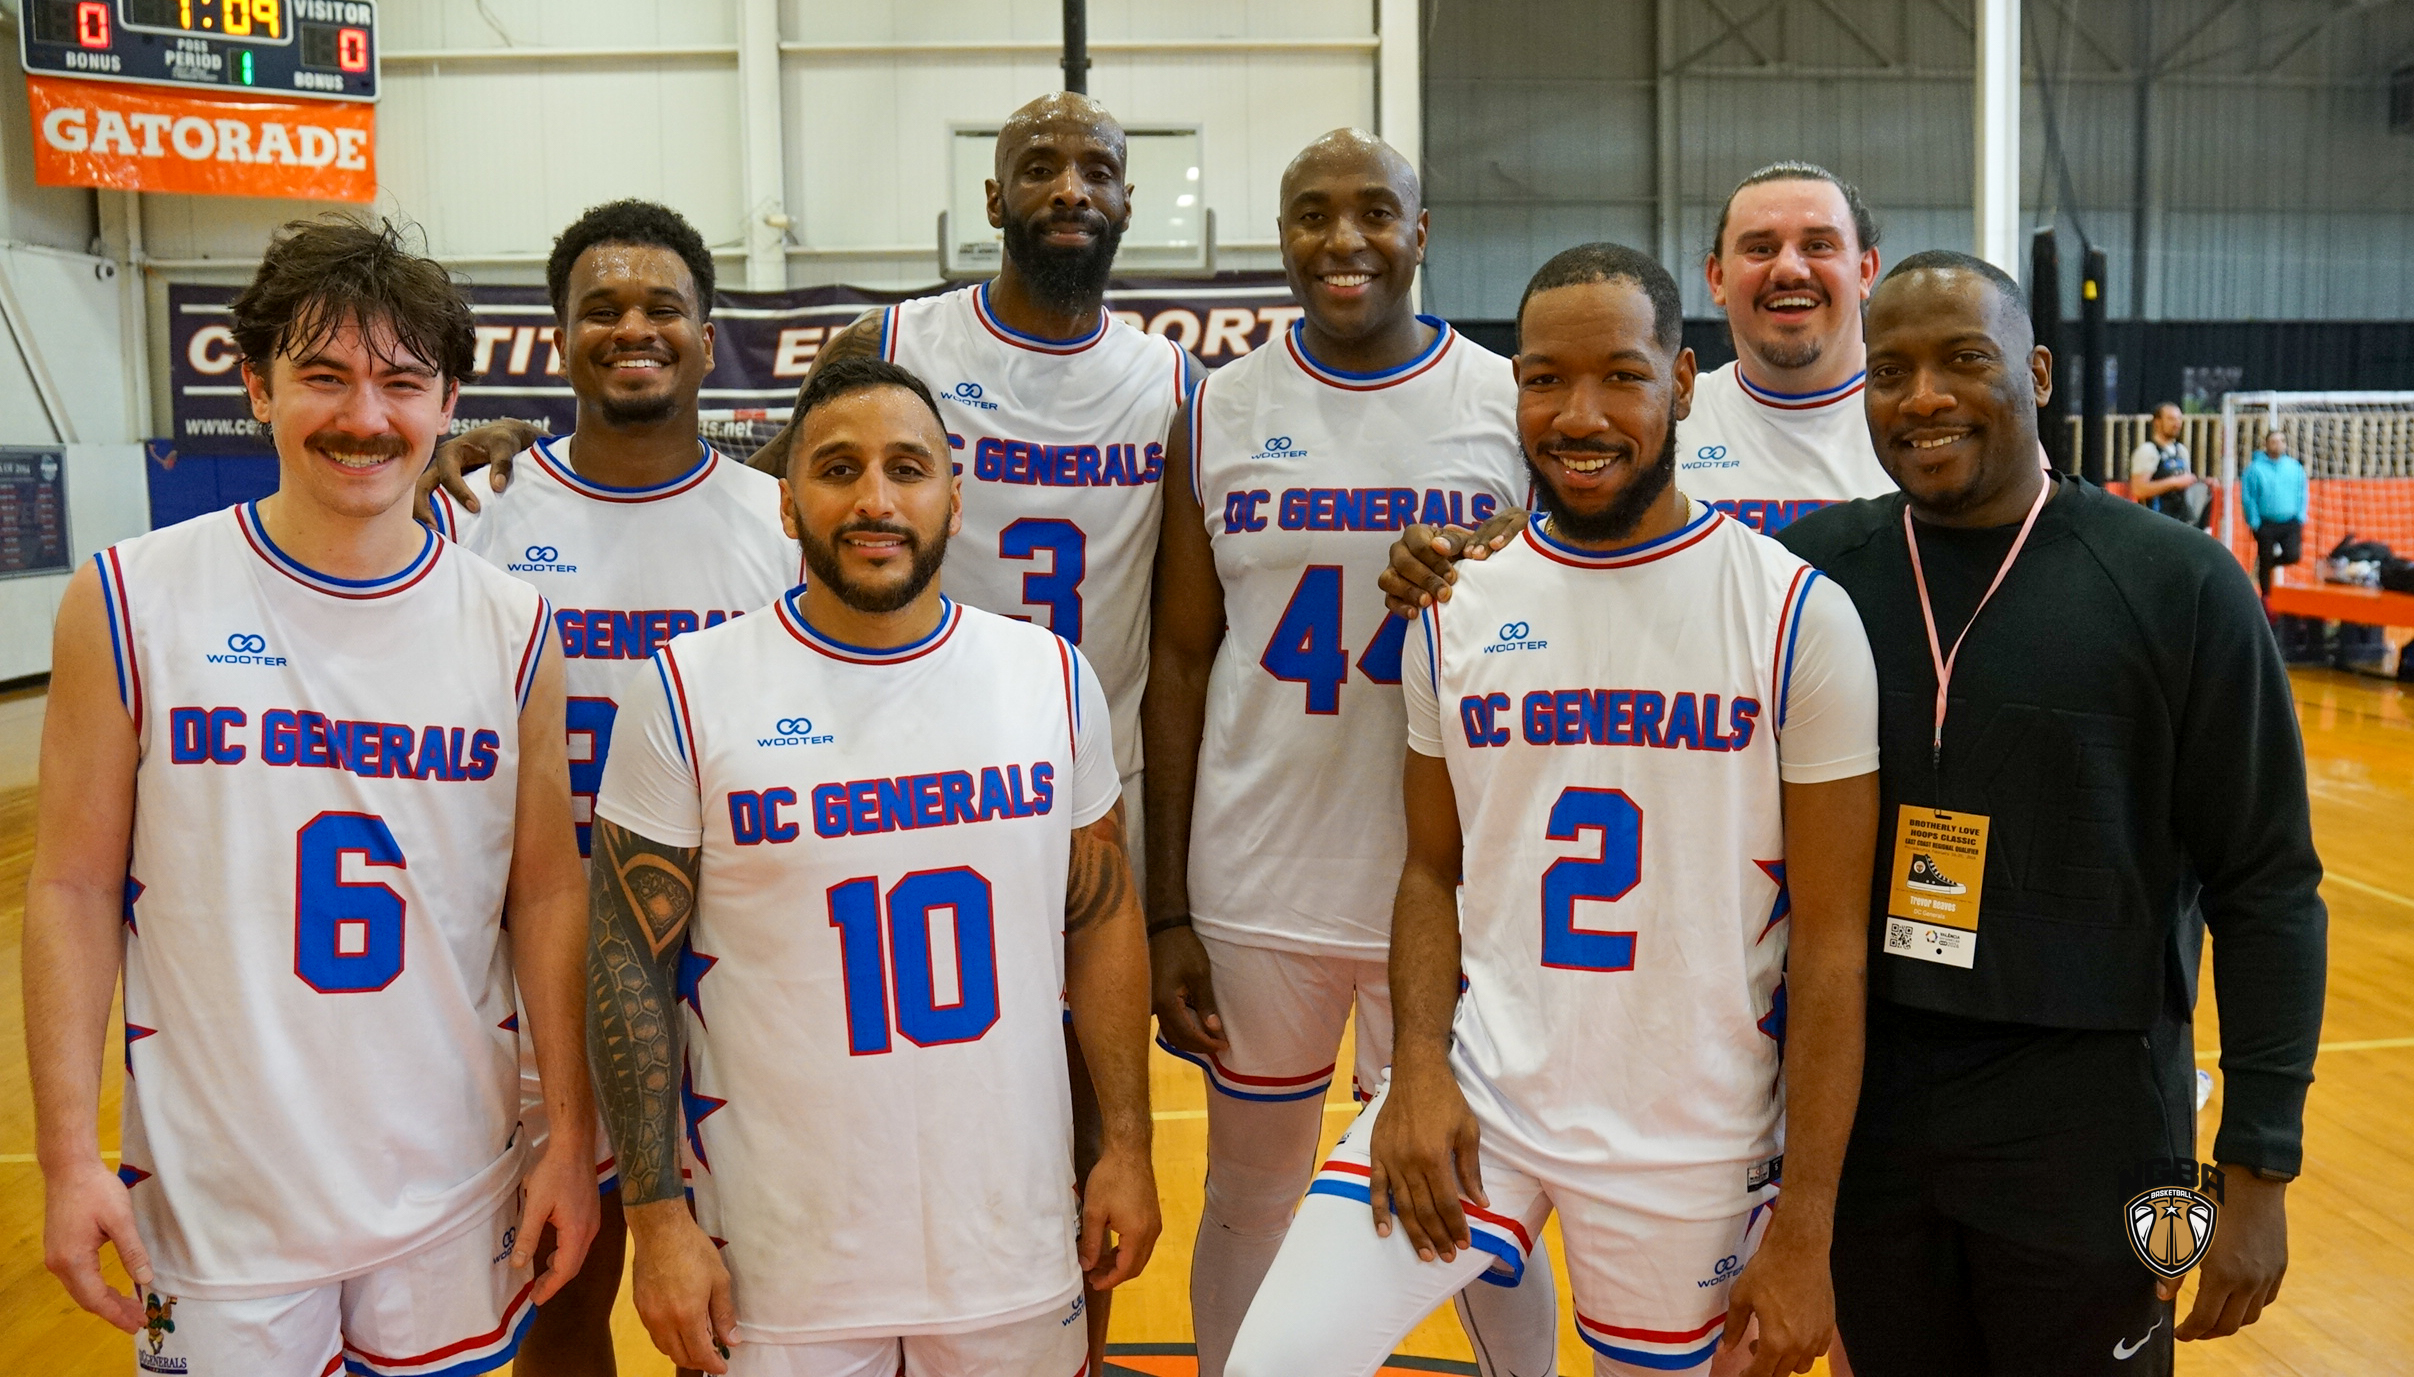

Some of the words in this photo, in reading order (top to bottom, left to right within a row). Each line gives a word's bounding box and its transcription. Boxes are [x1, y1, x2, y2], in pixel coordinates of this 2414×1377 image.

[79, 1, 109, 48] 0
[294, 0, 371, 25] VISITOR
[66, 50, 121, 72] BONUS
[165, 50, 222, 71] PERIOD
[340, 29, 367, 72] 0
[242, 51, 253, 86] 1
[293, 71, 344, 91] BONUS
[42, 108, 367, 170] GATORADE
[940, 391, 998, 411] WOOTER
[974, 436, 1165, 487] GENERALS
[1251, 449, 1308, 460] WOOTER
[1681, 460, 1740, 470] WOOTER
[1224, 489, 1271, 534] DC
[1278, 487, 1497, 531] GENERALS
[507, 563, 577, 573] WOOTER
[999, 517, 1087, 647] 3
[1484, 640, 1548, 654] WOOTER
[206, 654, 287, 667] WOOTER
[1460, 692, 1511, 749] DC
[1522, 688, 1761, 752] GENERALS
[170, 707, 247, 765] DC
[261, 708, 500, 781] GENERALS
[757, 734, 834, 747] WOOTER
[728, 787, 800, 846] DC
[811, 761, 1054, 839] GENERALS
[1909, 819, 1957, 832] BROTHERLY
[1959, 826, 1980, 836] LOVE
[1910, 829, 1938, 840] HOOPS
[1941, 834, 1976, 846] CLASSIC
[1917, 839, 1931, 848] COAST
[1932, 842, 1954, 851] REGIONAL
[1541, 786, 1643, 973] 2
[294, 811, 407, 994] 6
[826, 865, 1001, 1056] 10
